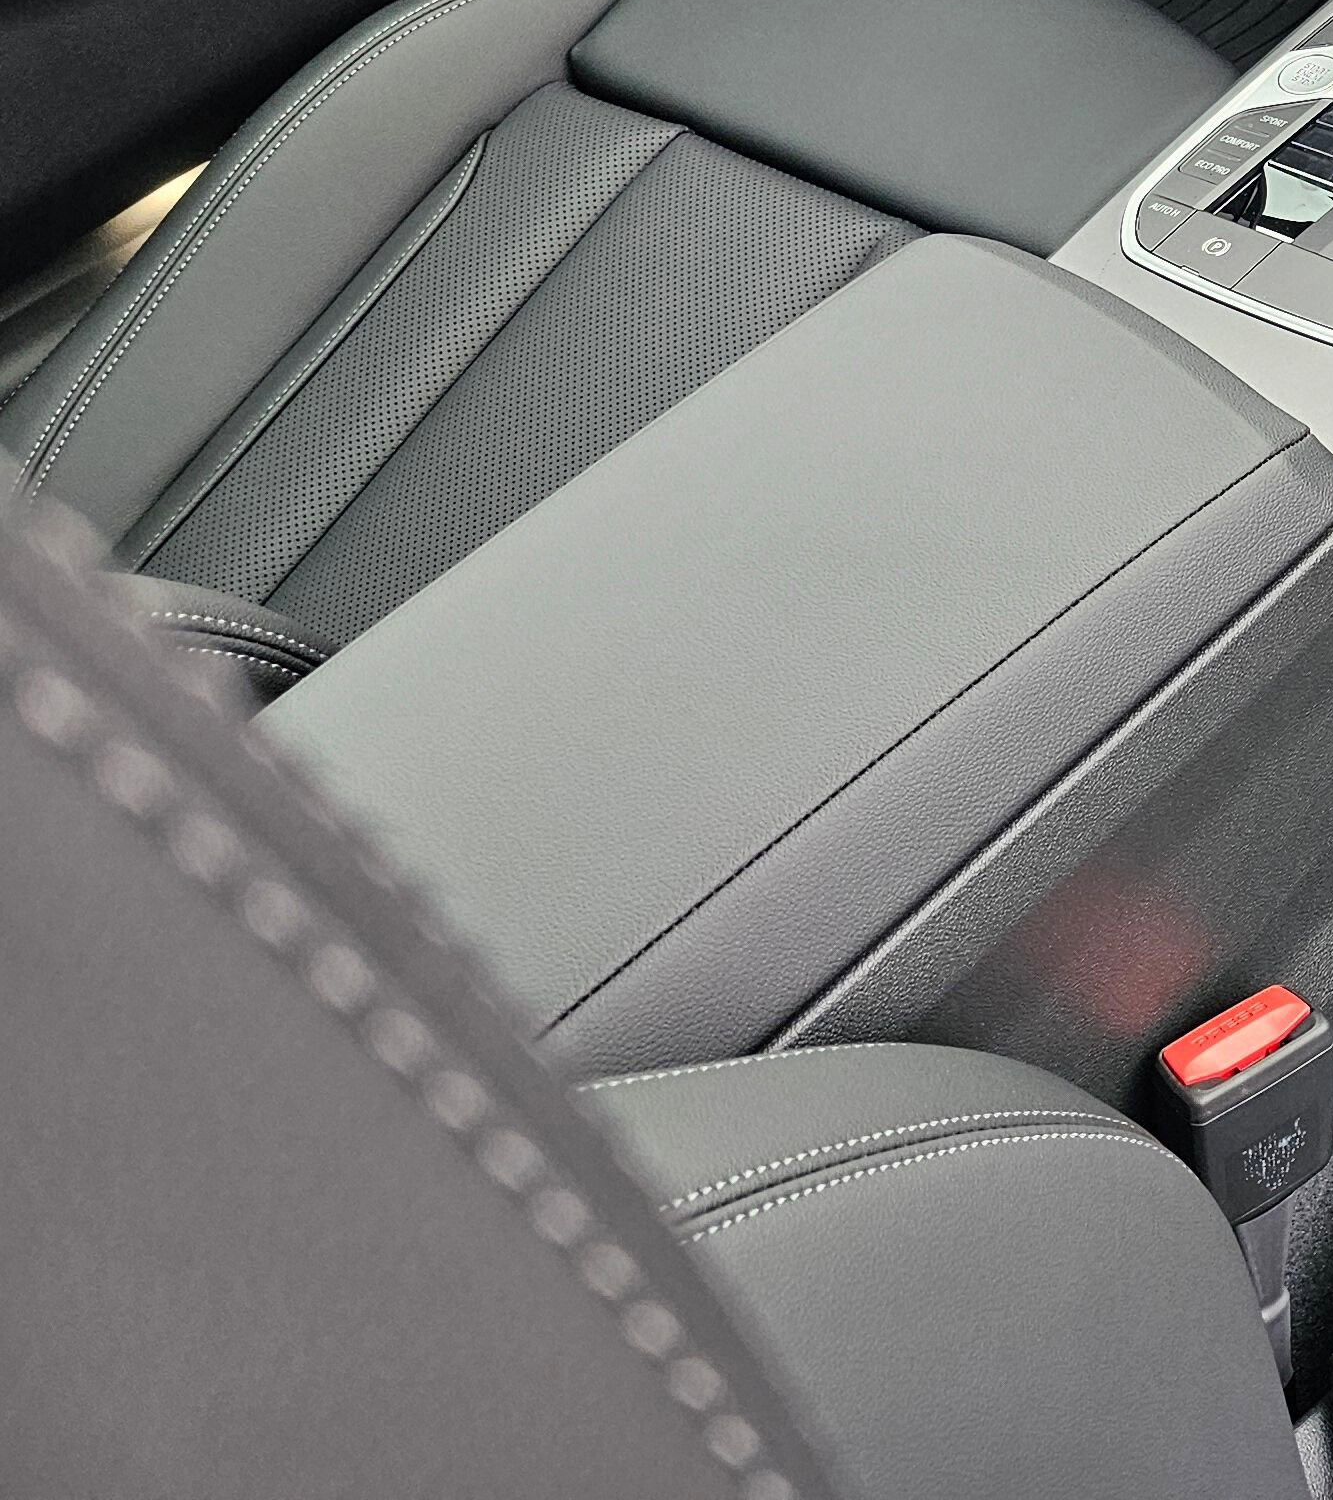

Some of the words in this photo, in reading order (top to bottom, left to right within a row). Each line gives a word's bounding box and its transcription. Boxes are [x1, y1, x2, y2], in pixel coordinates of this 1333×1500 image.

[1259, 114, 1288, 128] SPORT
[1219, 134, 1260, 151] COMFORT
[1194, 159, 1213, 172] ECO
[1213, 164, 1231, 176] PRO
[1148, 202, 1171, 216] AUTO
[1170, 208, 1181, 218] H
[1190, 1003, 1268, 1047] PRESS
